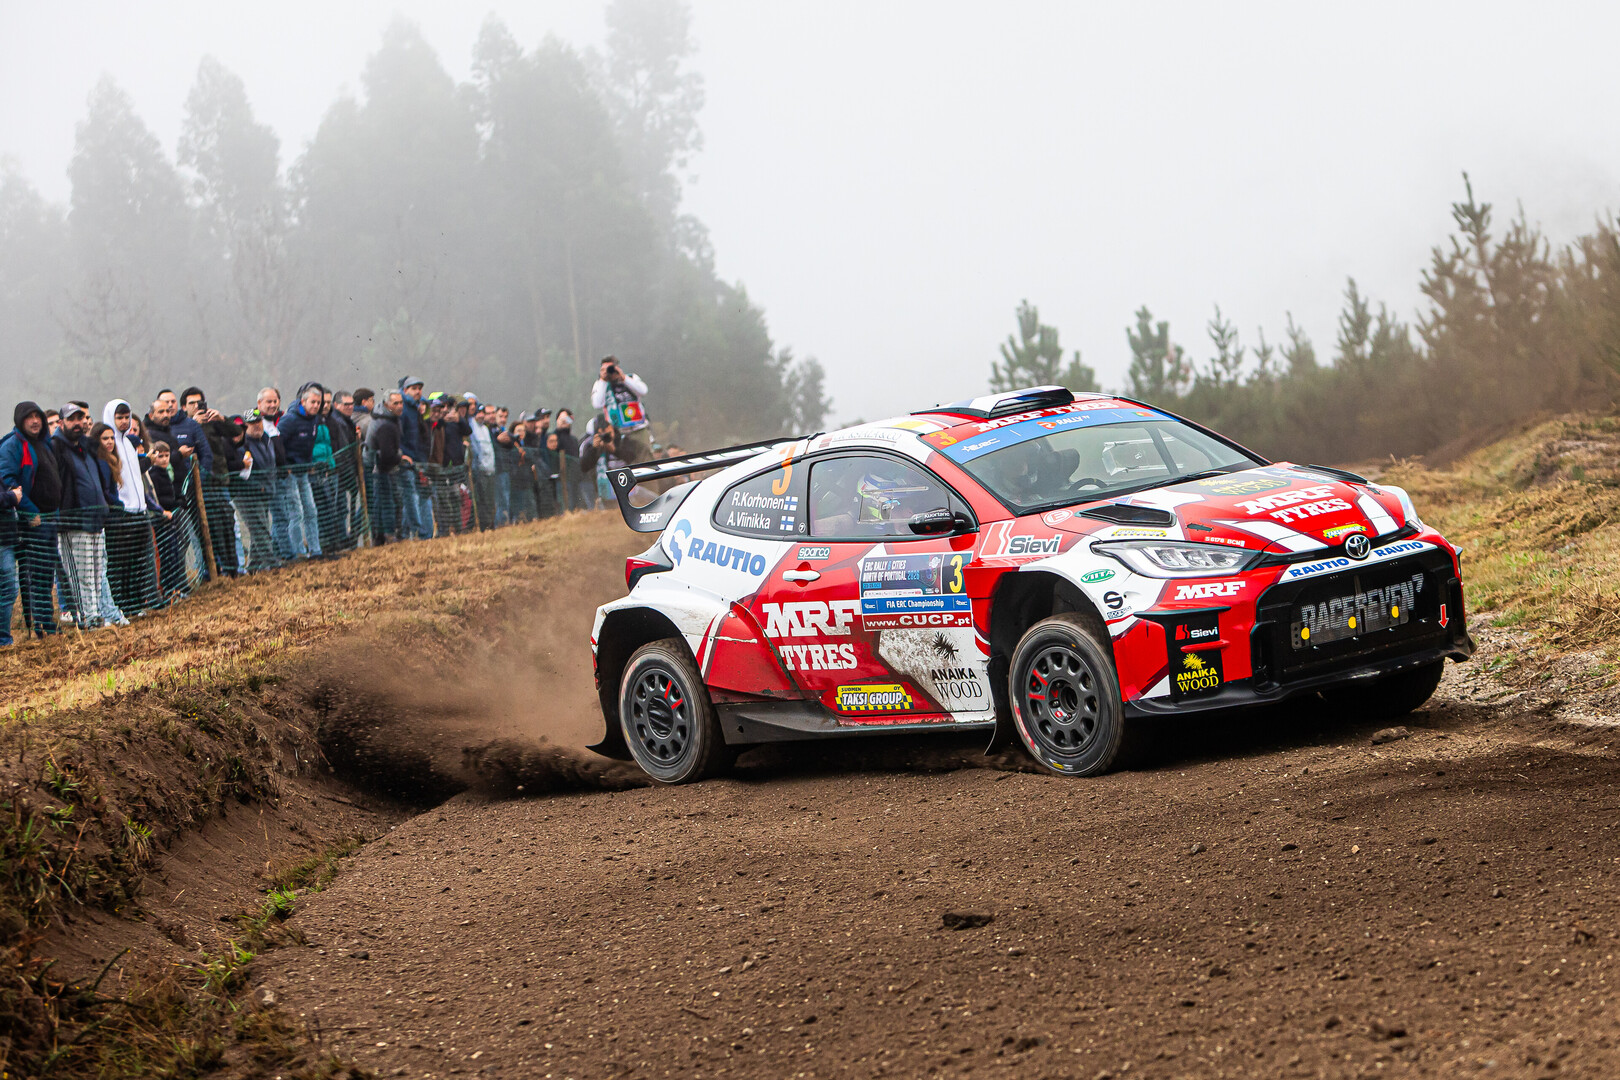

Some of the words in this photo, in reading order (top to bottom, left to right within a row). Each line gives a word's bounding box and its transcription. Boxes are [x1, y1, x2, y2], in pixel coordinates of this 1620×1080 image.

[972, 411, 1046, 432] MRF
[1044, 402, 1120, 416] TYRES
[1056, 415, 1083, 425] RALLY
[929, 431, 957, 446] 3
[731, 492, 785, 510] R.Korhonen
[1234, 485, 1336, 515] MRF
[639, 512, 662, 524] MRF
[1269, 498, 1353, 524] TYRES
[726, 511, 770, 529] A.Viinikka
[799, 546, 830, 559] sparco
[1009, 536, 1061, 554] Sievi
[687, 537, 766, 576] RAUTIO
[1288, 558, 1350, 578] RAUTIO
[1373, 541, 1424, 557] RAUTIO
[864, 561, 874, 571] ERC
[873, 561, 888, 571] RALLY
[891, 560, 907, 570] CITIES
[949, 555, 963, 593] 3
[863, 571, 878, 582] NORTH
[878, 572, 885, 581] OF
[884, 571, 907, 581] PORTUGAL
[1082, 570, 1115, 582] VIITA
[1412, 572, 1424, 593] 7
[1174, 581, 1246, 600] MRF
[886, 600, 896, 608] FIA
[896, 600, 906, 608] ERC
[908, 599, 945, 608] Championship
[762, 601, 863, 638] MRF
[866, 614, 970, 627] www.CUCP.pt
[1190, 627, 1218, 639] Sievi
[778, 643, 858, 671] TYRES
[931, 668, 977, 682] ANAIKA
[1176, 668, 1217, 682] ANAIKA
[1177, 675, 1219, 692] WOOD
[842, 692, 868, 706] TAKSI
[869, 691, 903, 706] GROUP
[935, 682, 983, 699] WOOD
